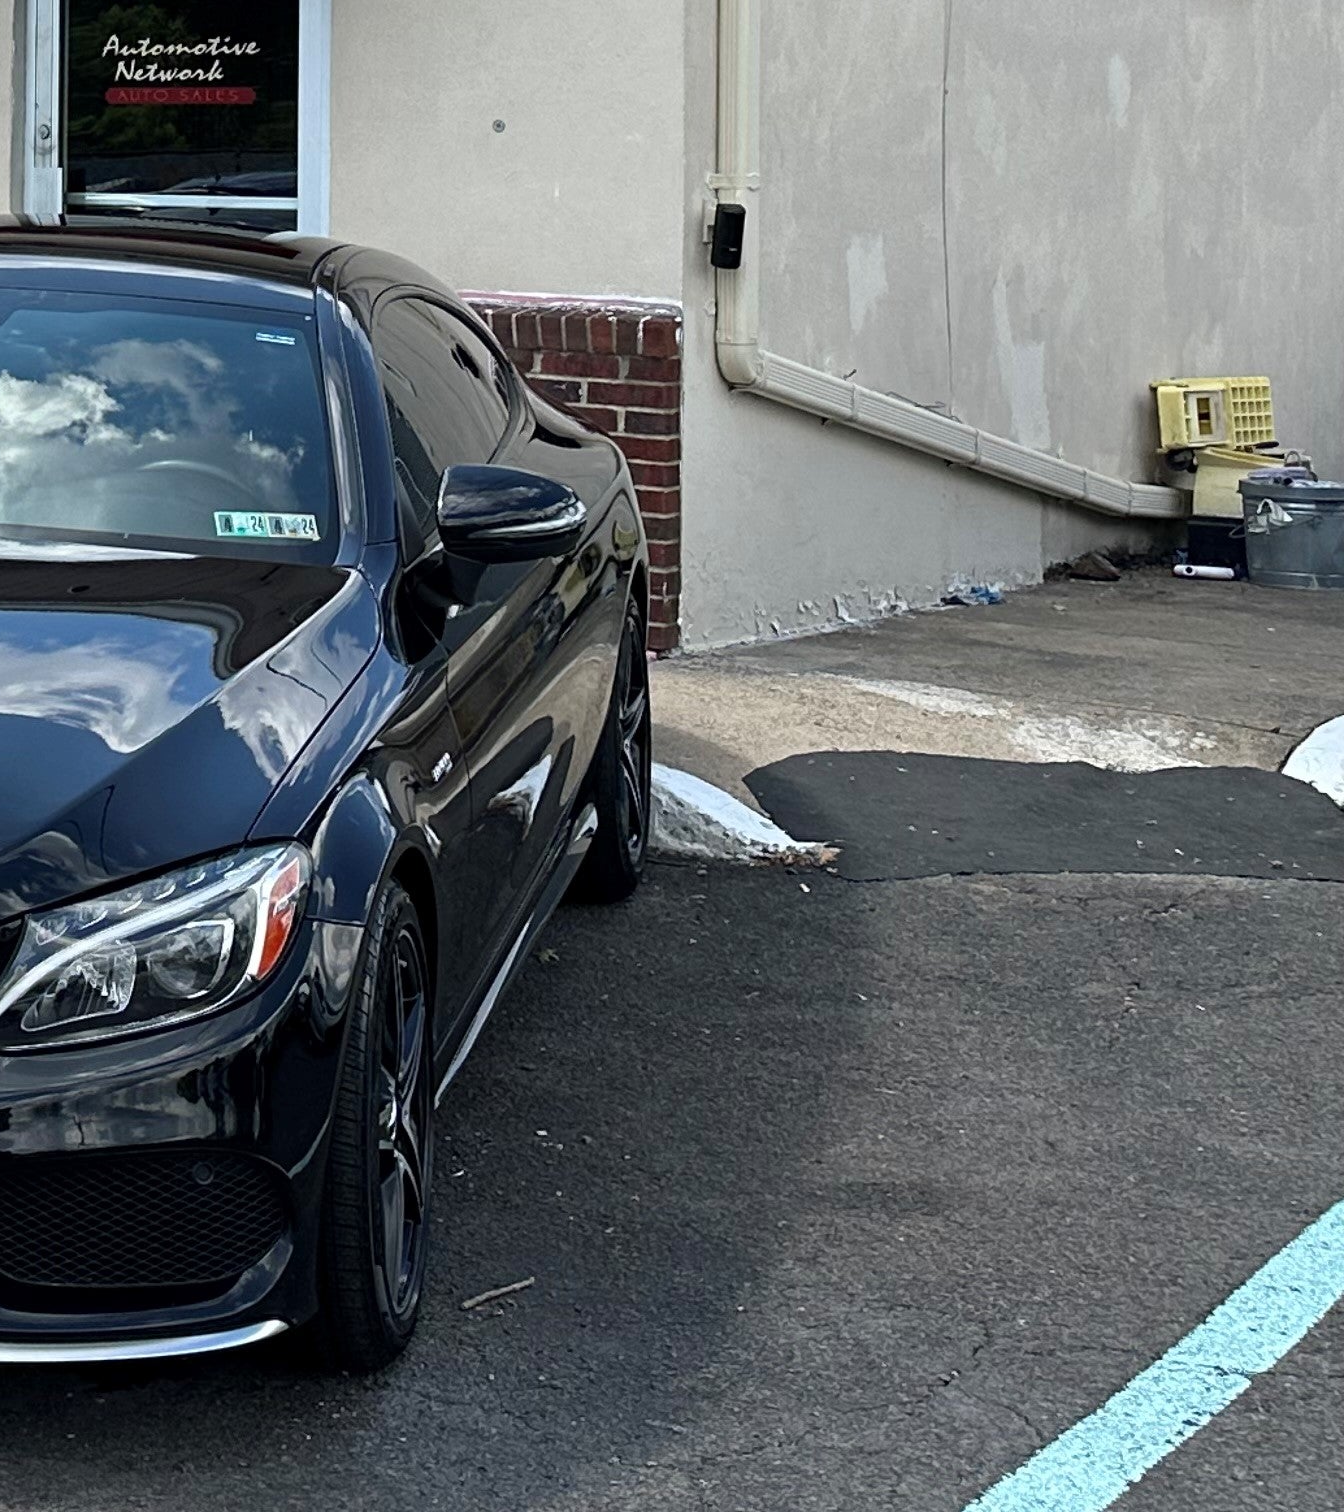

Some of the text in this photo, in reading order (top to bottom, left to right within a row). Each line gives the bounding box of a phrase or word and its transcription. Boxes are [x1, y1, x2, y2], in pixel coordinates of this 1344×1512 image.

[102, 34, 261, 58] Automotive
[114, 60, 225, 83] Network
[119, 89, 239, 102] AUTO SALES
